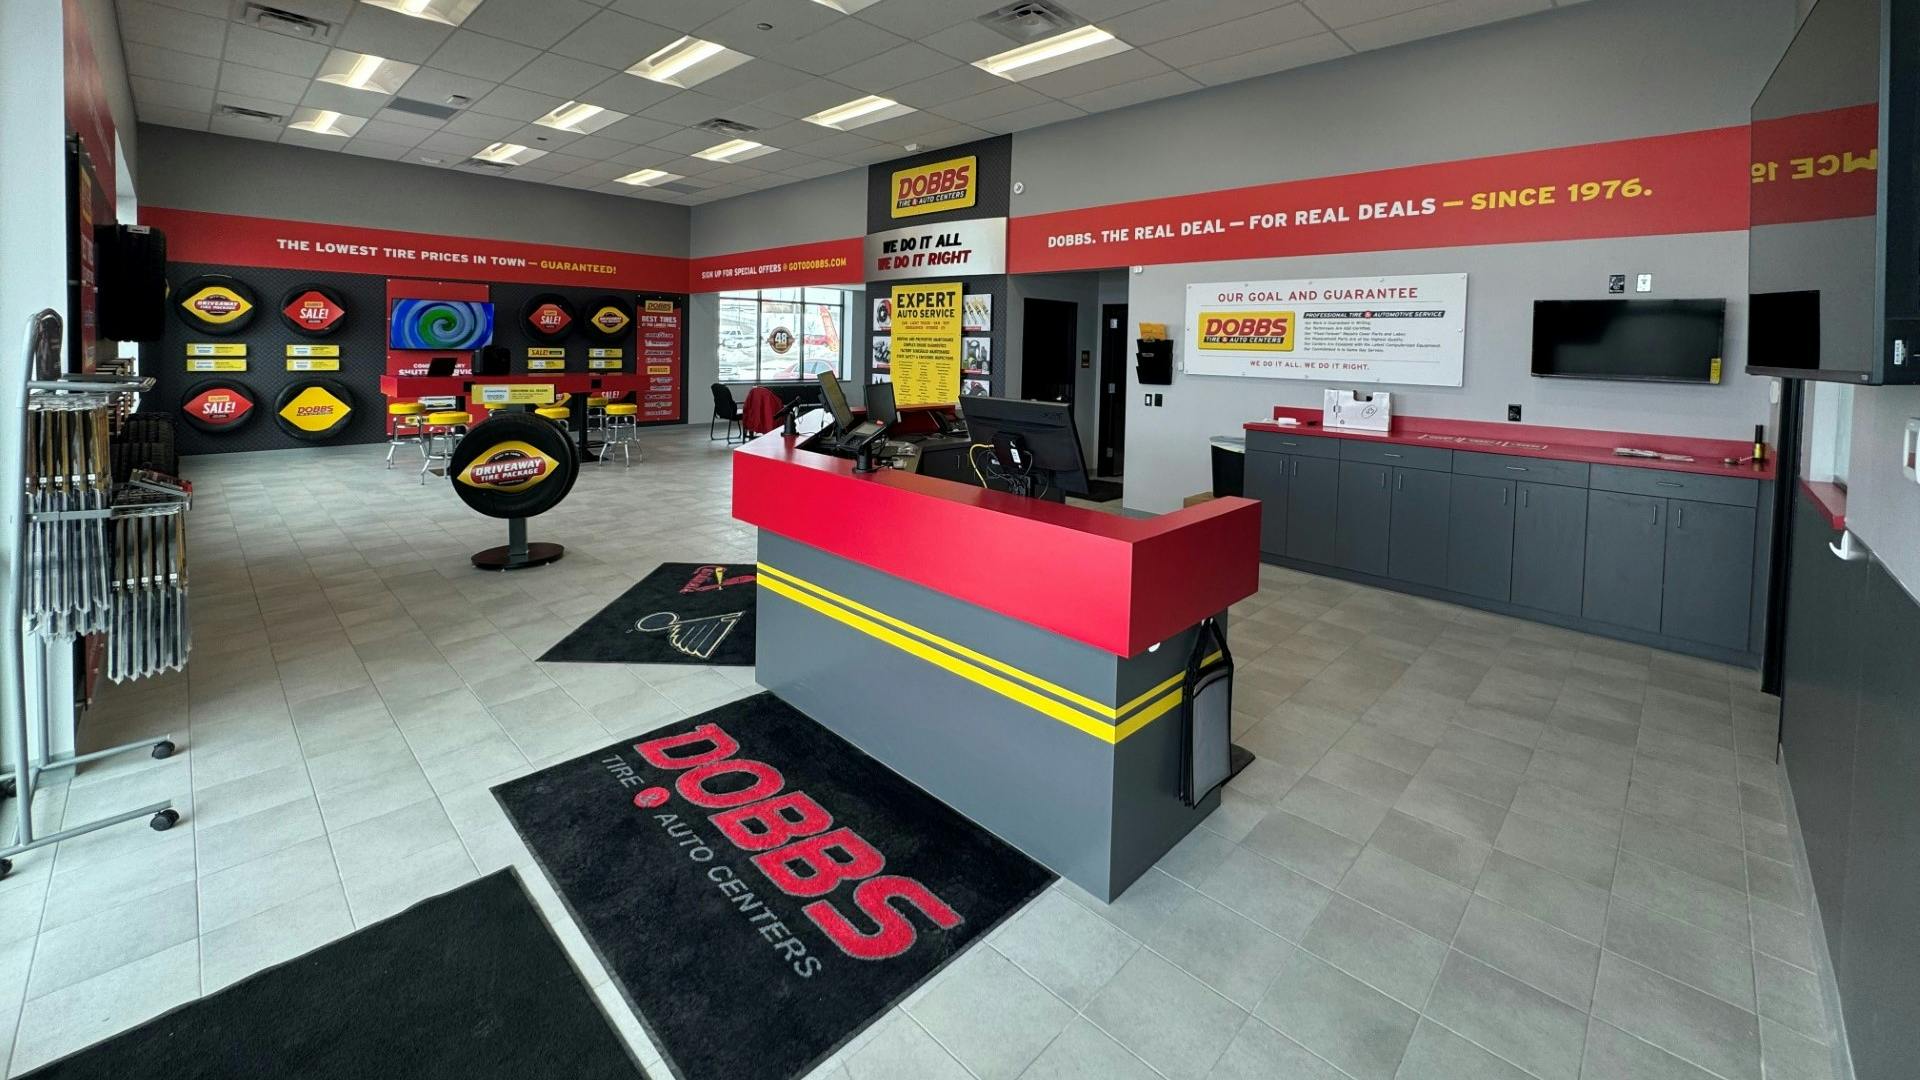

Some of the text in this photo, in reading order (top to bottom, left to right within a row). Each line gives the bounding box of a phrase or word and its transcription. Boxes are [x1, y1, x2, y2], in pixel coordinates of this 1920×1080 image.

[898, 165, 970, 200] DOBBS
[919, 196, 934, 204] AUTO
[936, 190, 964, 201] CENTERS
[1048, 232, 1096, 248] DOBBS.
[1101, 228, 1129, 242] THE
[1134, 225, 1174, 240] REAL
[1181, 219, 1225, 236] DEAL
[1250, 212, 1287, 229] FOR
[1295, 206, 1350, 226] REAL
[1358, 198, 1436, 220] DEALS
[1471, 186, 1556, 210] SINCE
[1568, 178, 1652, 202] 1976.
[883, 233, 962, 254] WE DO IT ALL
[276, 238, 310, 251] THE
[316, 242, 378, 256] LOWEST
[383, 248, 416, 260] TIRE
[421, 250, 468, 262] PRICES
[474, 255, 486, 264] IN
[491, 256, 526, 267] TOWN
[540, 260, 616, 274] GUARANTEED!
[878, 250, 972, 271] WE DO IT RIGHT
[722, 268, 732, 276] FOR
[734, 266, 756, 276] SPECIAL
[758, 264, 782, 274] OFFERS
[789, 258, 846, 270] GOTODOBBS.COM
[897, 292, 956, 308] EXPERT
[1218, 288, 1418, 302] OUR GOAL AND GUARANTEE
[300, 308, 328, 320] SALE!
[540, 316, 561, 324] SALE!
[897, 308, 955, 318] AUTO SERVICE
[1206, 318, 1288, 336] DOBBS
[202, 402, 236, 414] SALE!
[298, 405, 334, 413] DOBBS
[475, 460, 541, 476] DRIVEAWAY
[502, 468, 538, 478] PACKAGE
[634, 723, 964, 960] DOBBS
[602, 754, 645, 788] TIRE
[654, 814, 714, 861] AUTO
[708, 866, 822, 978] CENTERS
